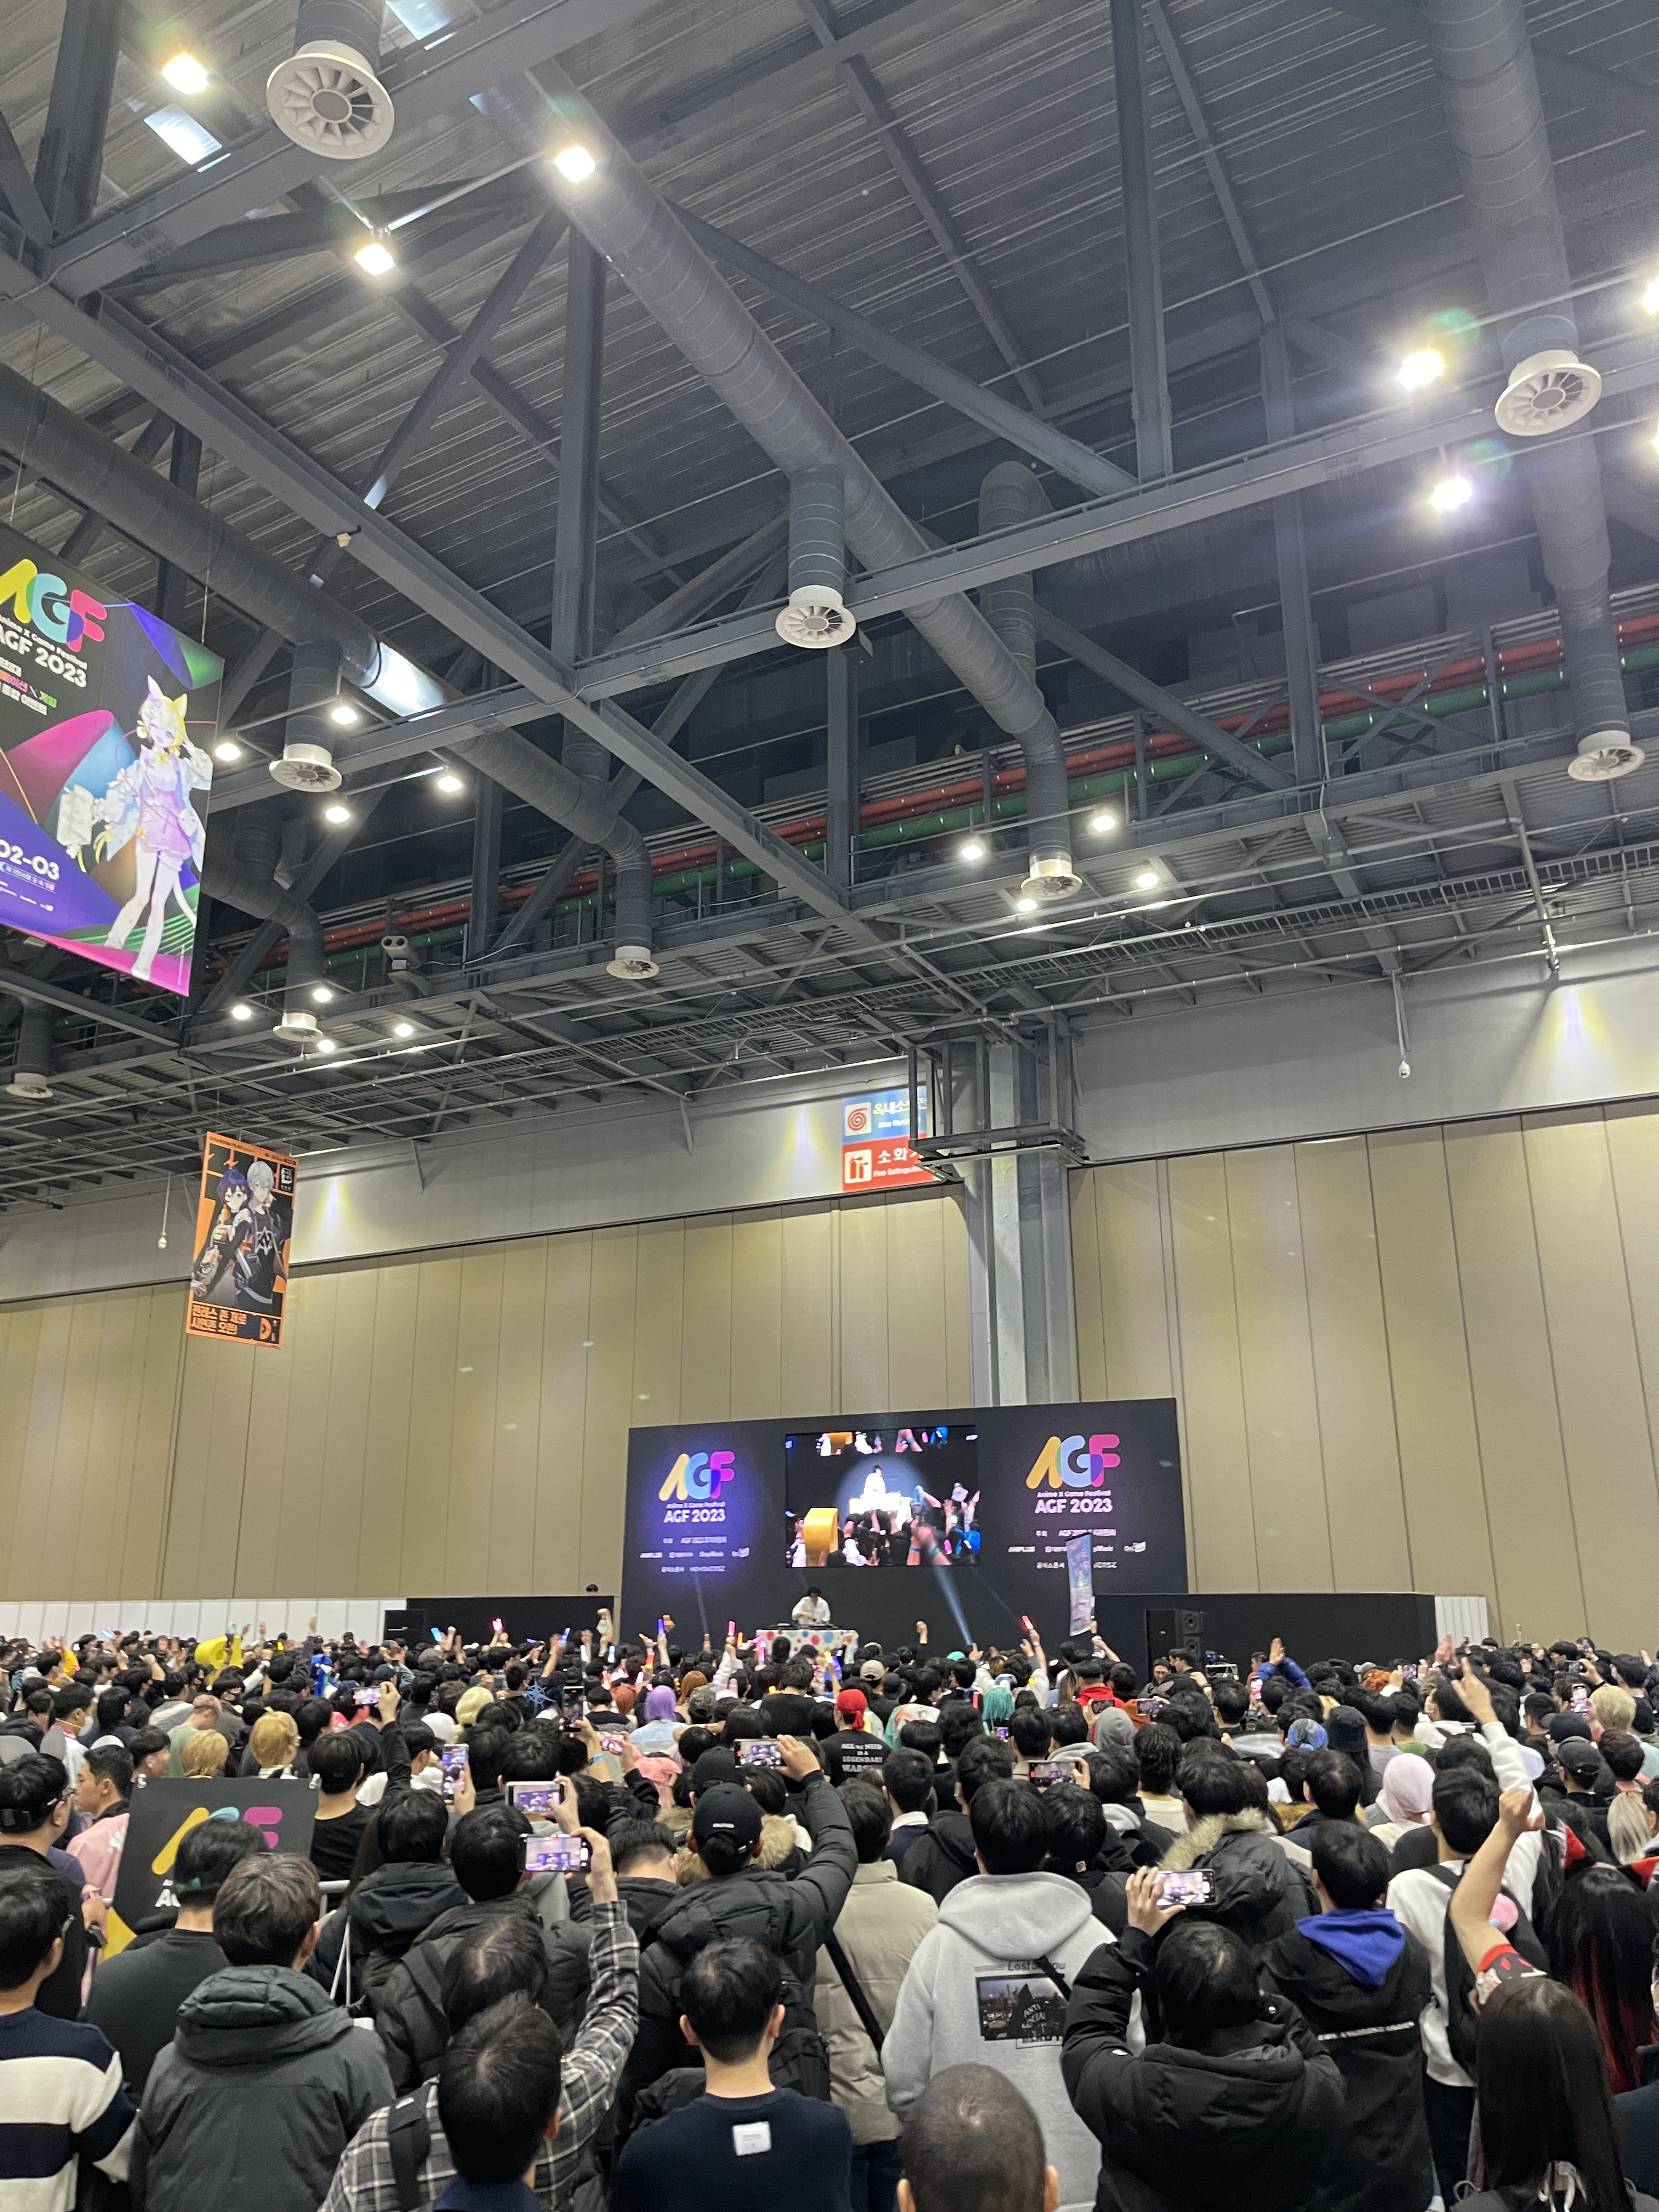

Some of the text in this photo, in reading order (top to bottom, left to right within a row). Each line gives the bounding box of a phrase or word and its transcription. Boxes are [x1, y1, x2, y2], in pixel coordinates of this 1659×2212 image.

[35, 647, 87, 688] 2023
[658, 1451, 735, 1501] AGF
[1025, 1434, 1120, 1489] AGF
[663, 1509, 726, 1523] AGF 2023
[1035, 1498, 1113, 1514] AGF 2023
